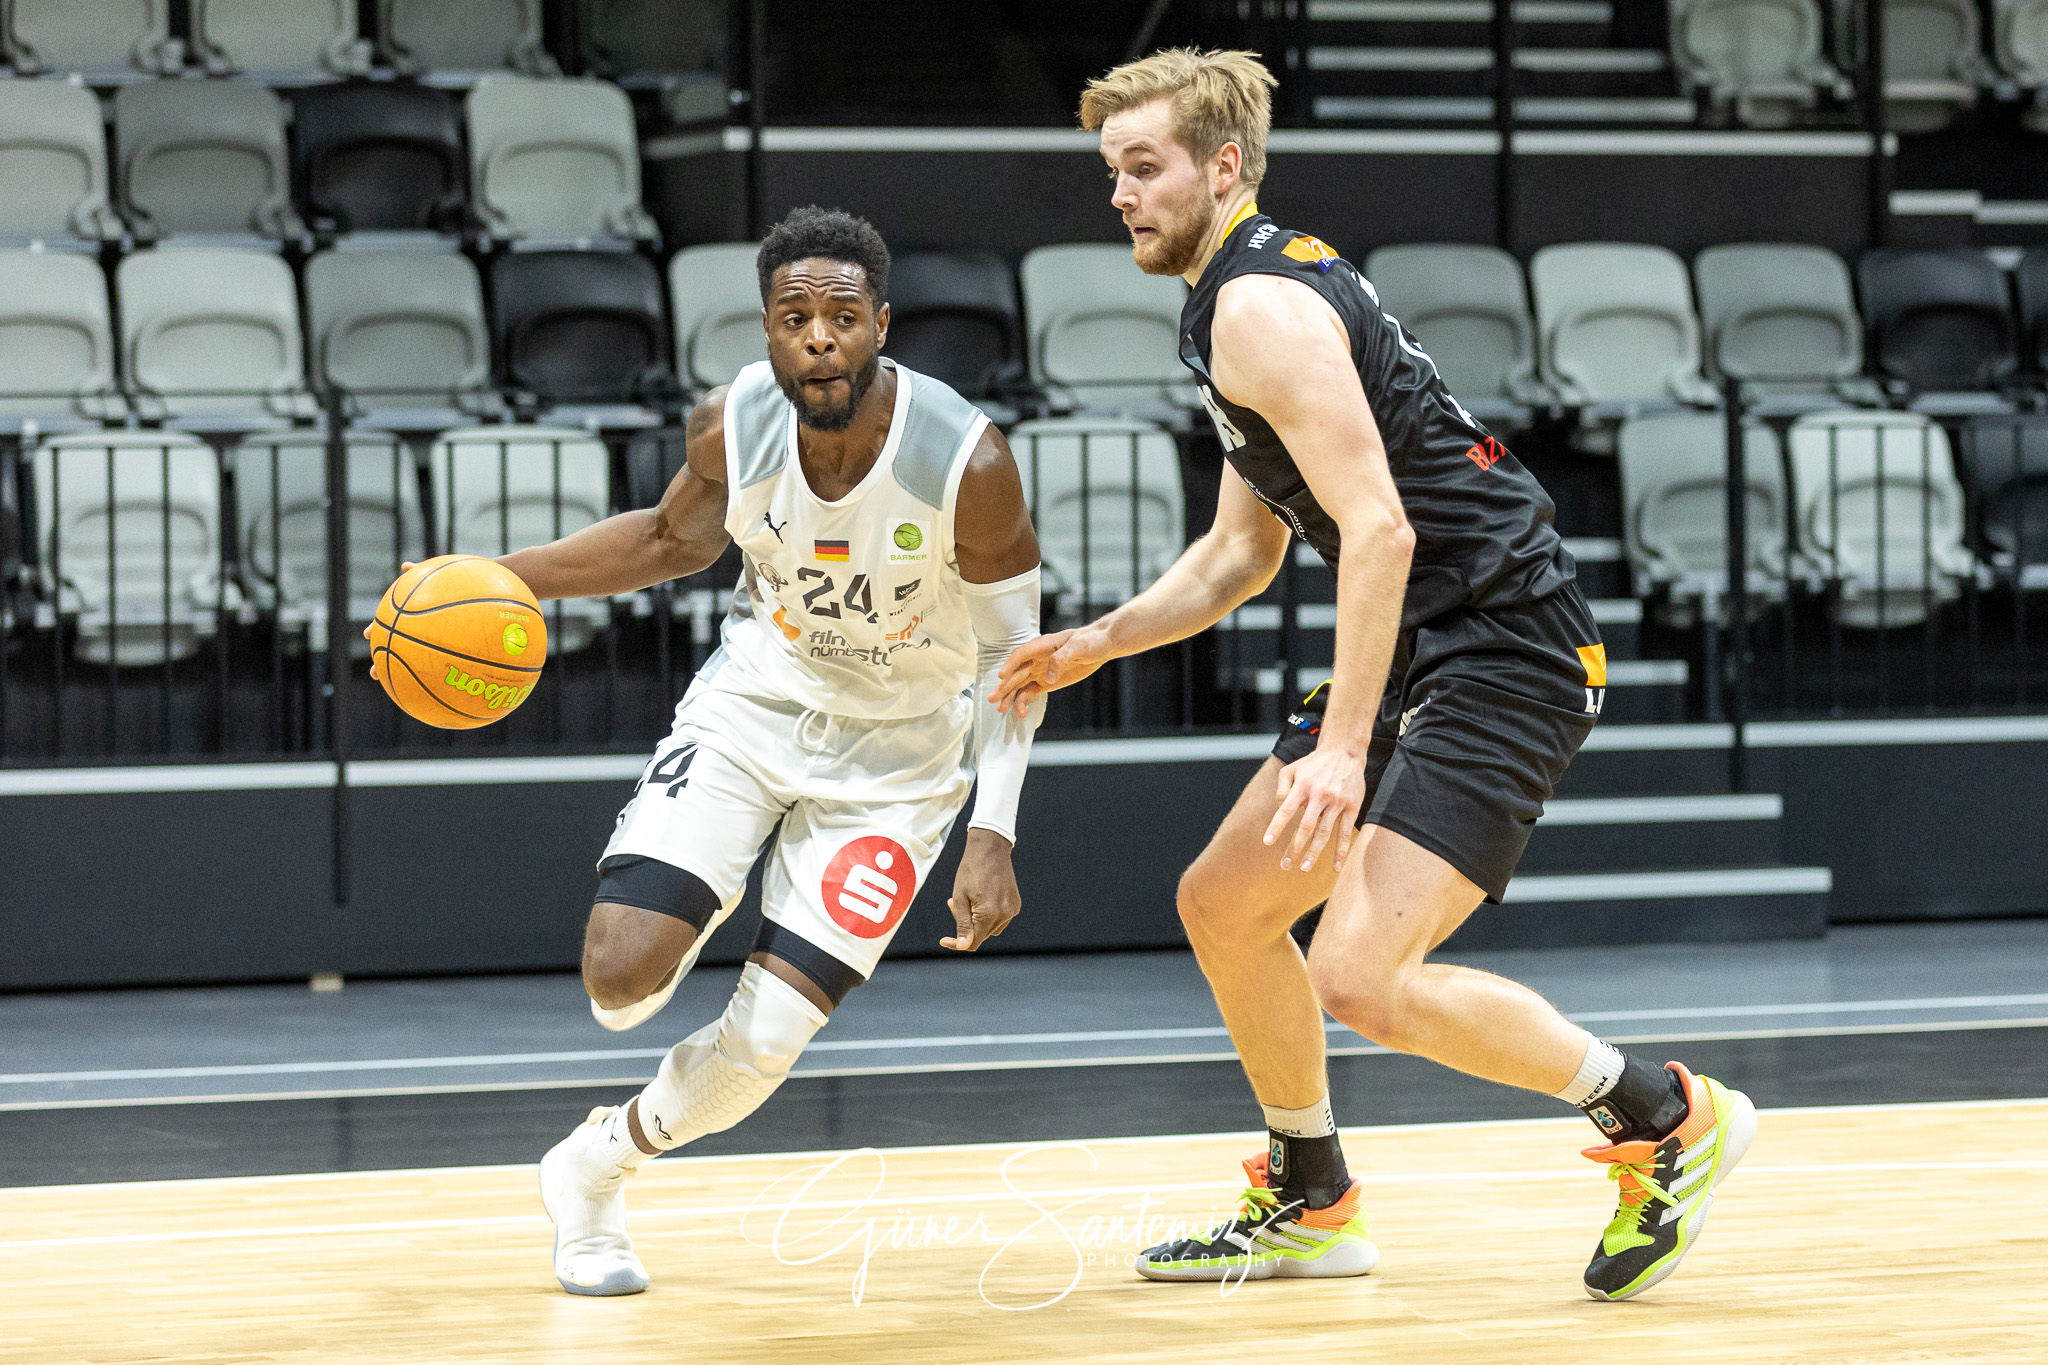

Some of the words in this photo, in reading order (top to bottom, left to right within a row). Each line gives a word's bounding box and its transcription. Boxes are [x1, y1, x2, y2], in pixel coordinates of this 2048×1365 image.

[889, 553, 928, 562] BARMER
[796, 566, 880, 624] 24
[634, 743, 699, 798] 4
